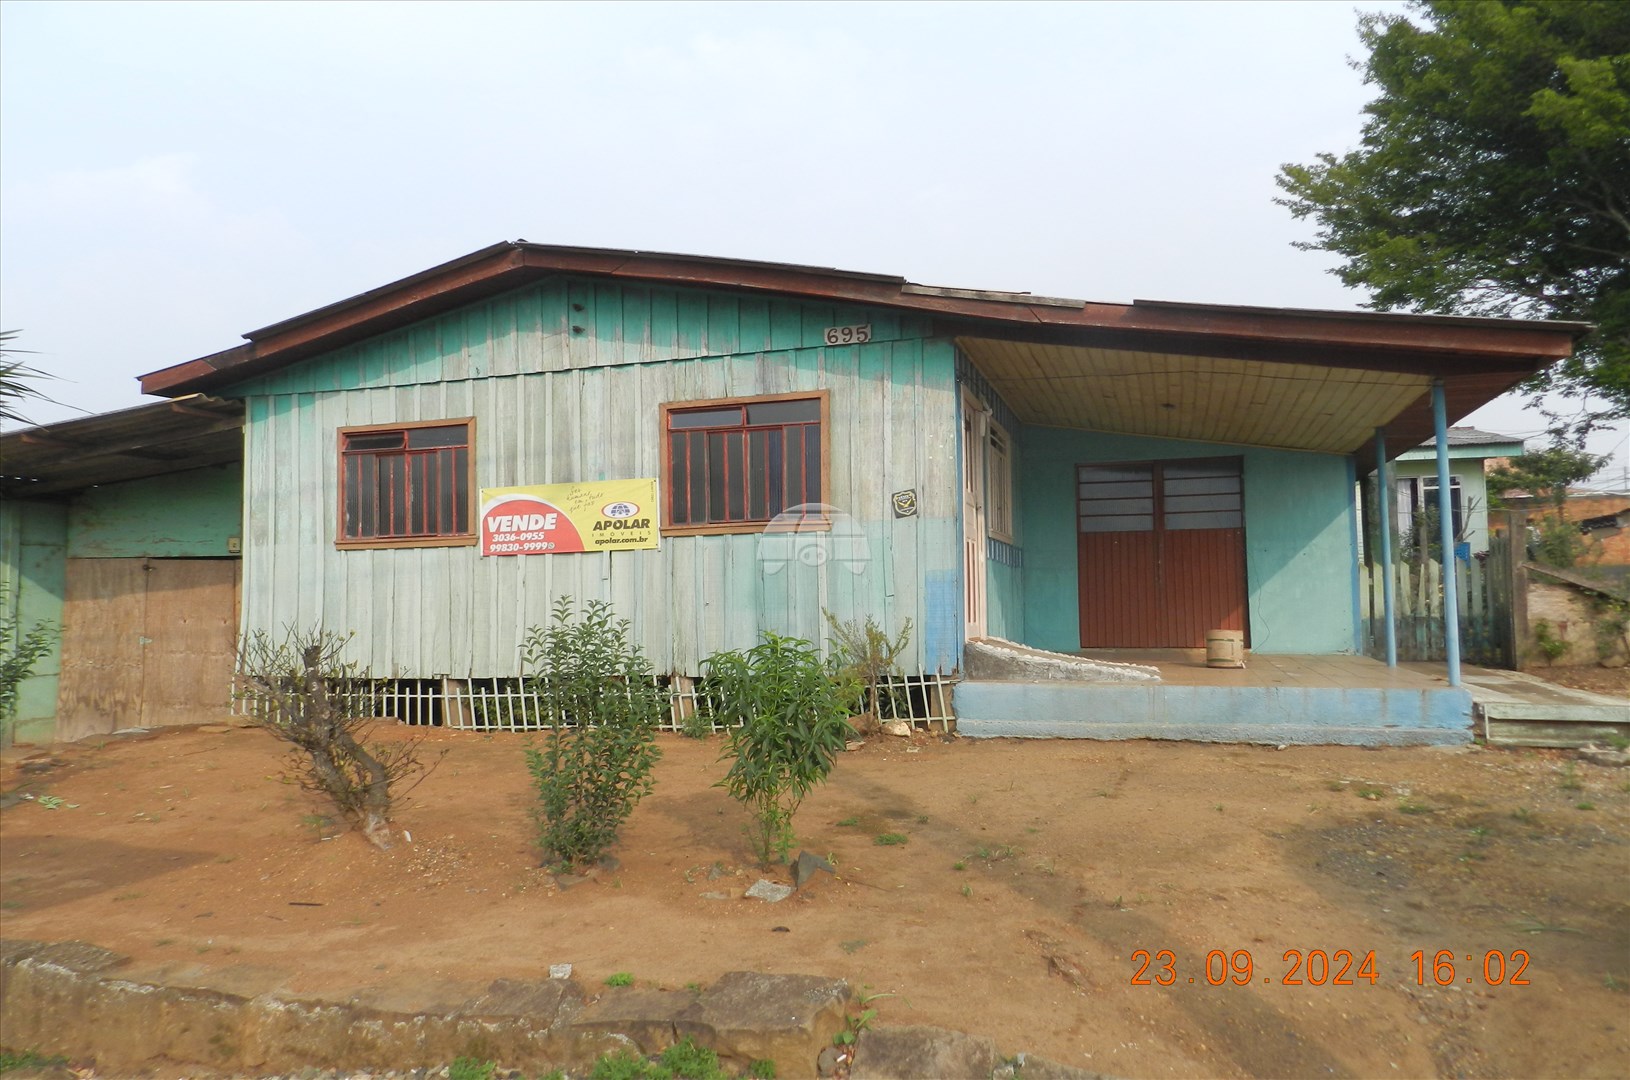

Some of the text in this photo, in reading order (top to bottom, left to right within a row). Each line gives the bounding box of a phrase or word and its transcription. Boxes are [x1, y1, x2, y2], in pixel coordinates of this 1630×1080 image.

[827, 325, 870, 344] 695
[487, 513, 558, 533] VENDE
[592, 518, 651, 531] APOLAR
[492, 532, 545, 542] 3036-0955
[594, 536, 649, 546] apolar.com.br
[489, 542, 548, 553] 99830-9999
